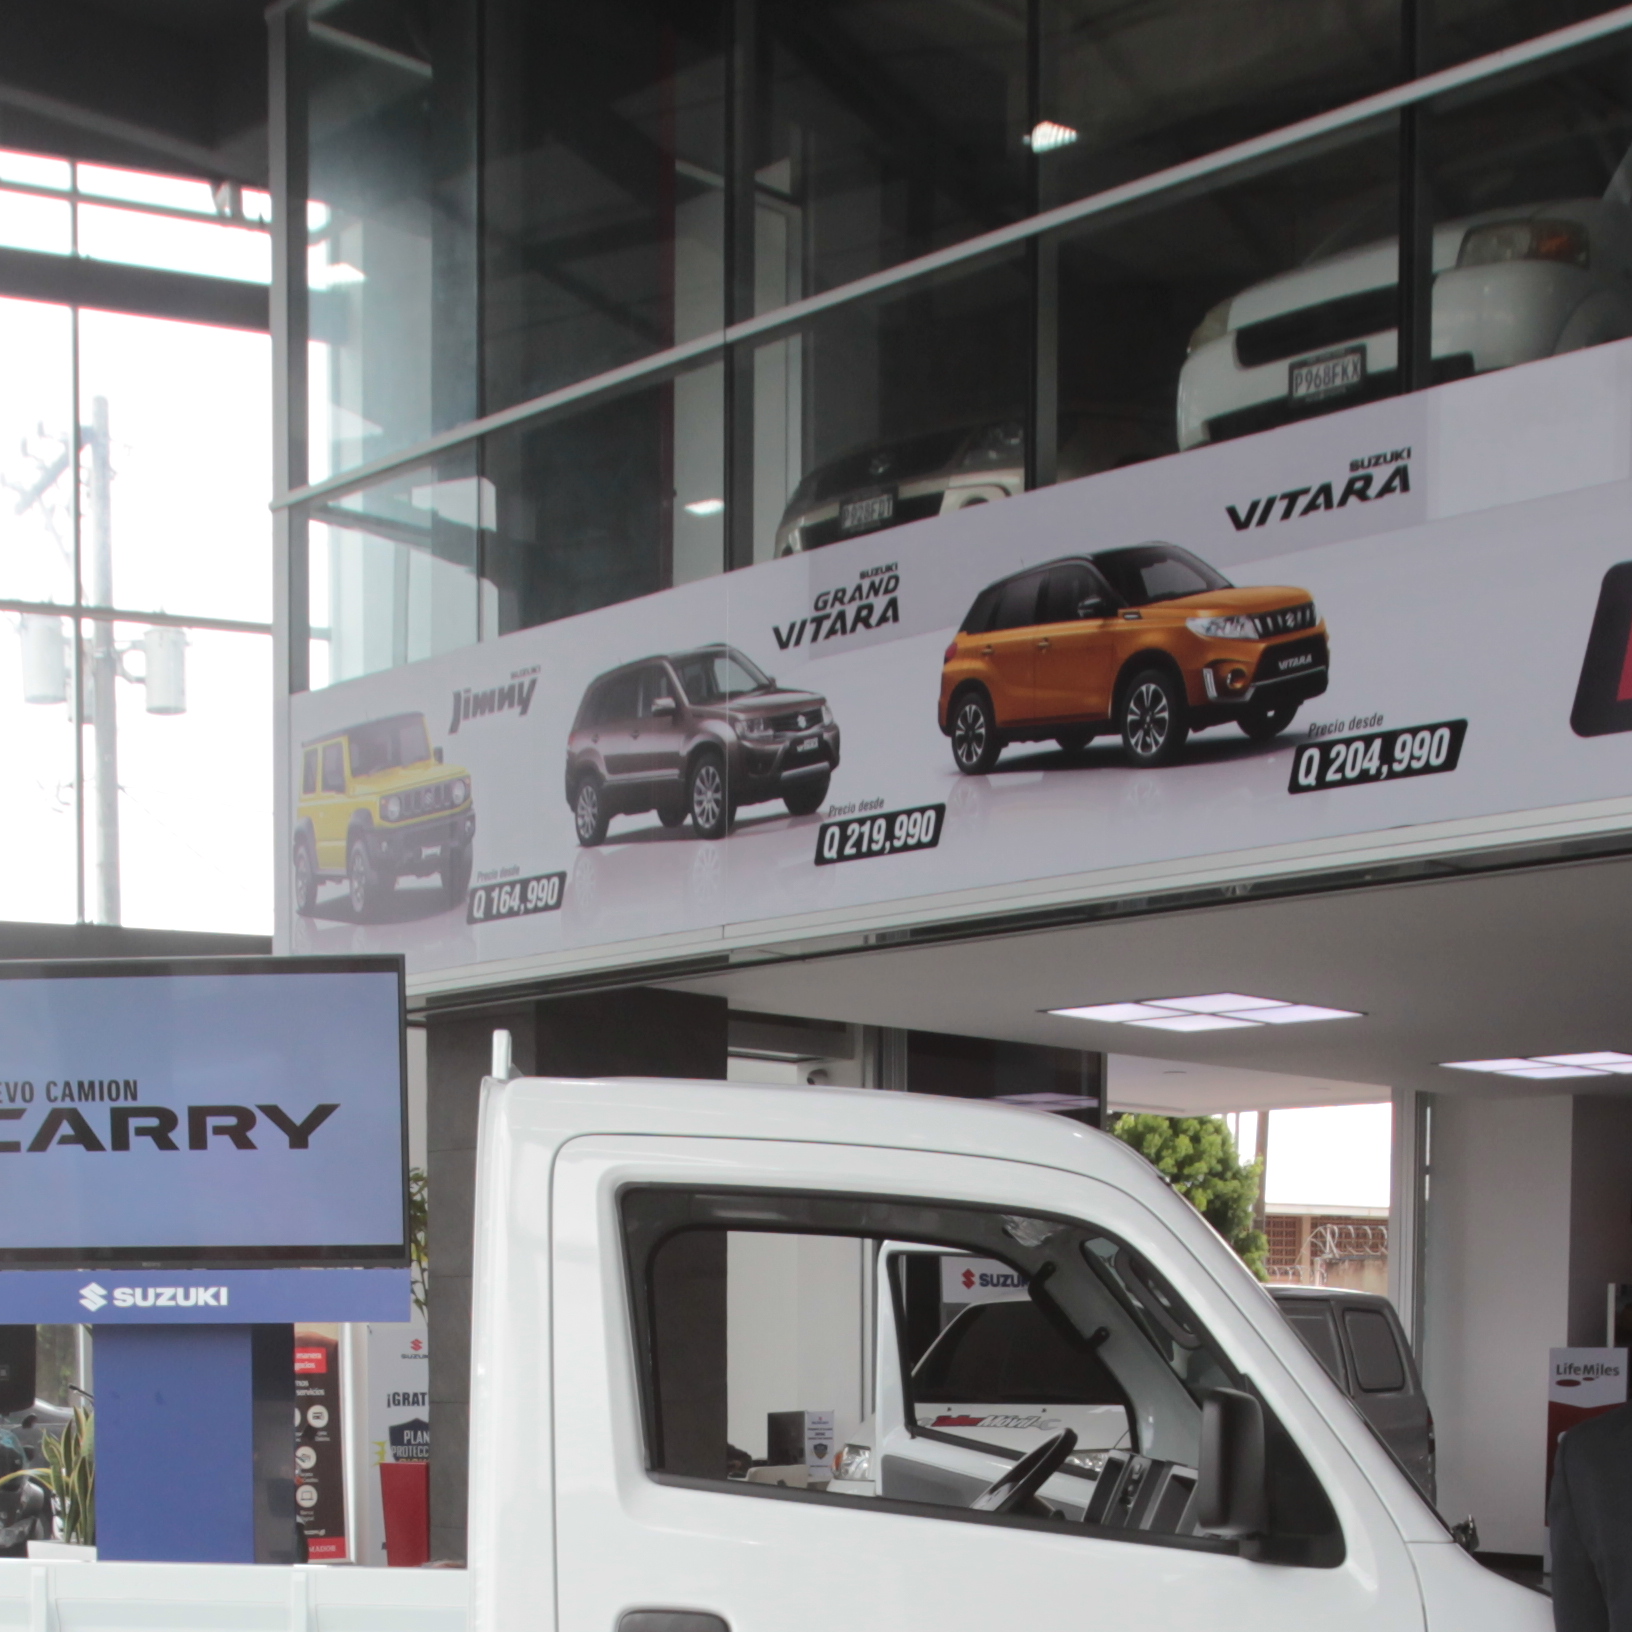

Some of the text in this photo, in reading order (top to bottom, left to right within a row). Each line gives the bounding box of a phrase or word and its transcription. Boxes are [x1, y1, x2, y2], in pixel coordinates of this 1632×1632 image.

[1349, 447, 1412, 472] SUZUKI
[1225, 463, 1410, 531] VITARA
[859, 562, 898, 579] SUZUKI
[814, 574, 900, 611] GRAND
[772, 596, 900, 650] VITARA
[448, 677, 538, 735] Jimny
[1308, 712, 1384, 737] Precio desde
[1298, 727, 1451, 787] Q 204,990
[828, 797, 885, 818] Precio desde
[823, 809, 936, 859] Q 219,990
[473, 876, 559, 919] Q 164,990
[45, 1079, 138, 1103] CAMION
[113, 1286, 228, 1307] SUZUKI
[1556, 1363, 1620, 1377] LifeMiles
[403, 1430, 430, 1445] PLAN
